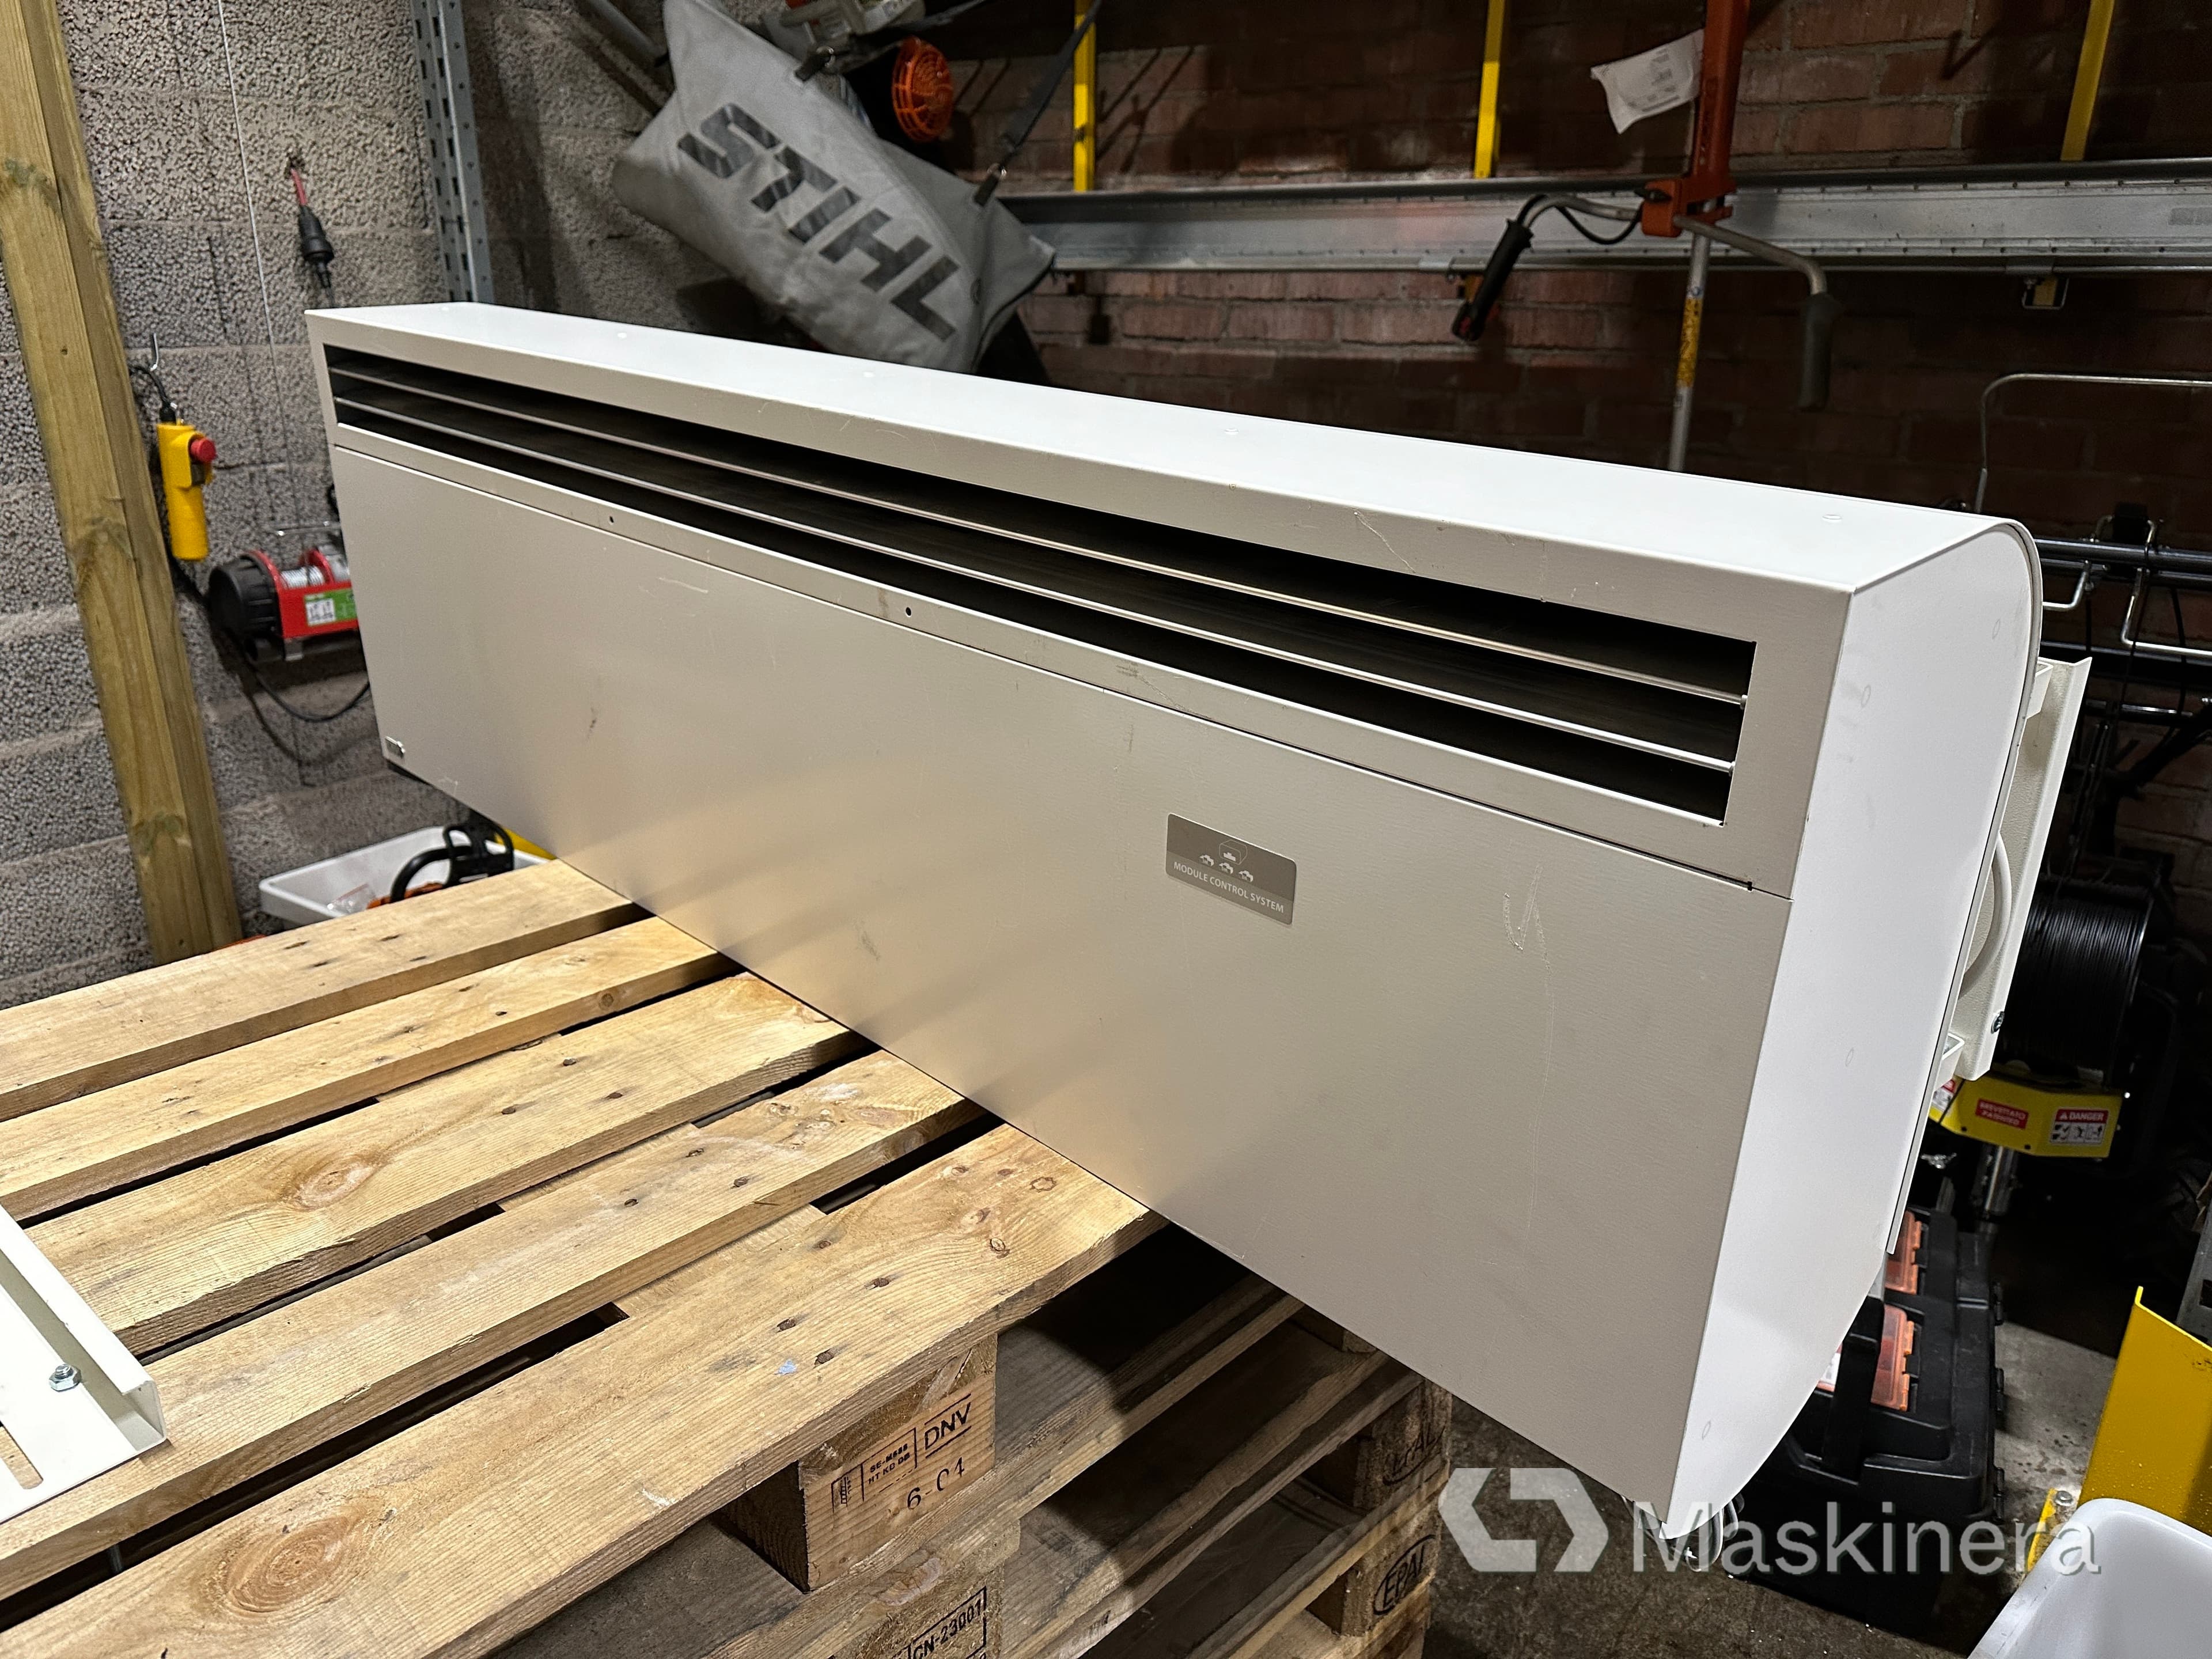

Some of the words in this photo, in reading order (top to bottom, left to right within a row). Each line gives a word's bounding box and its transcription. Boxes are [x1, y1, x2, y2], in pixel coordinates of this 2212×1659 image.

[678, 103, 960, 342] STIHL
[1173, 861, 1208, 882] MODULE
[1210, 876, 1249, 899] CONTROL
[1250, 892, 1284, 914] SYSTEM
[2069, 1111, 2105, 1122] DANGER
[925, 1402, 971, 1450] DNV
[868, 1472, 880, 1484] HT
[882, 1462, 896, 1476] KD
[913, 1599, 980, 1659] CN-23001
